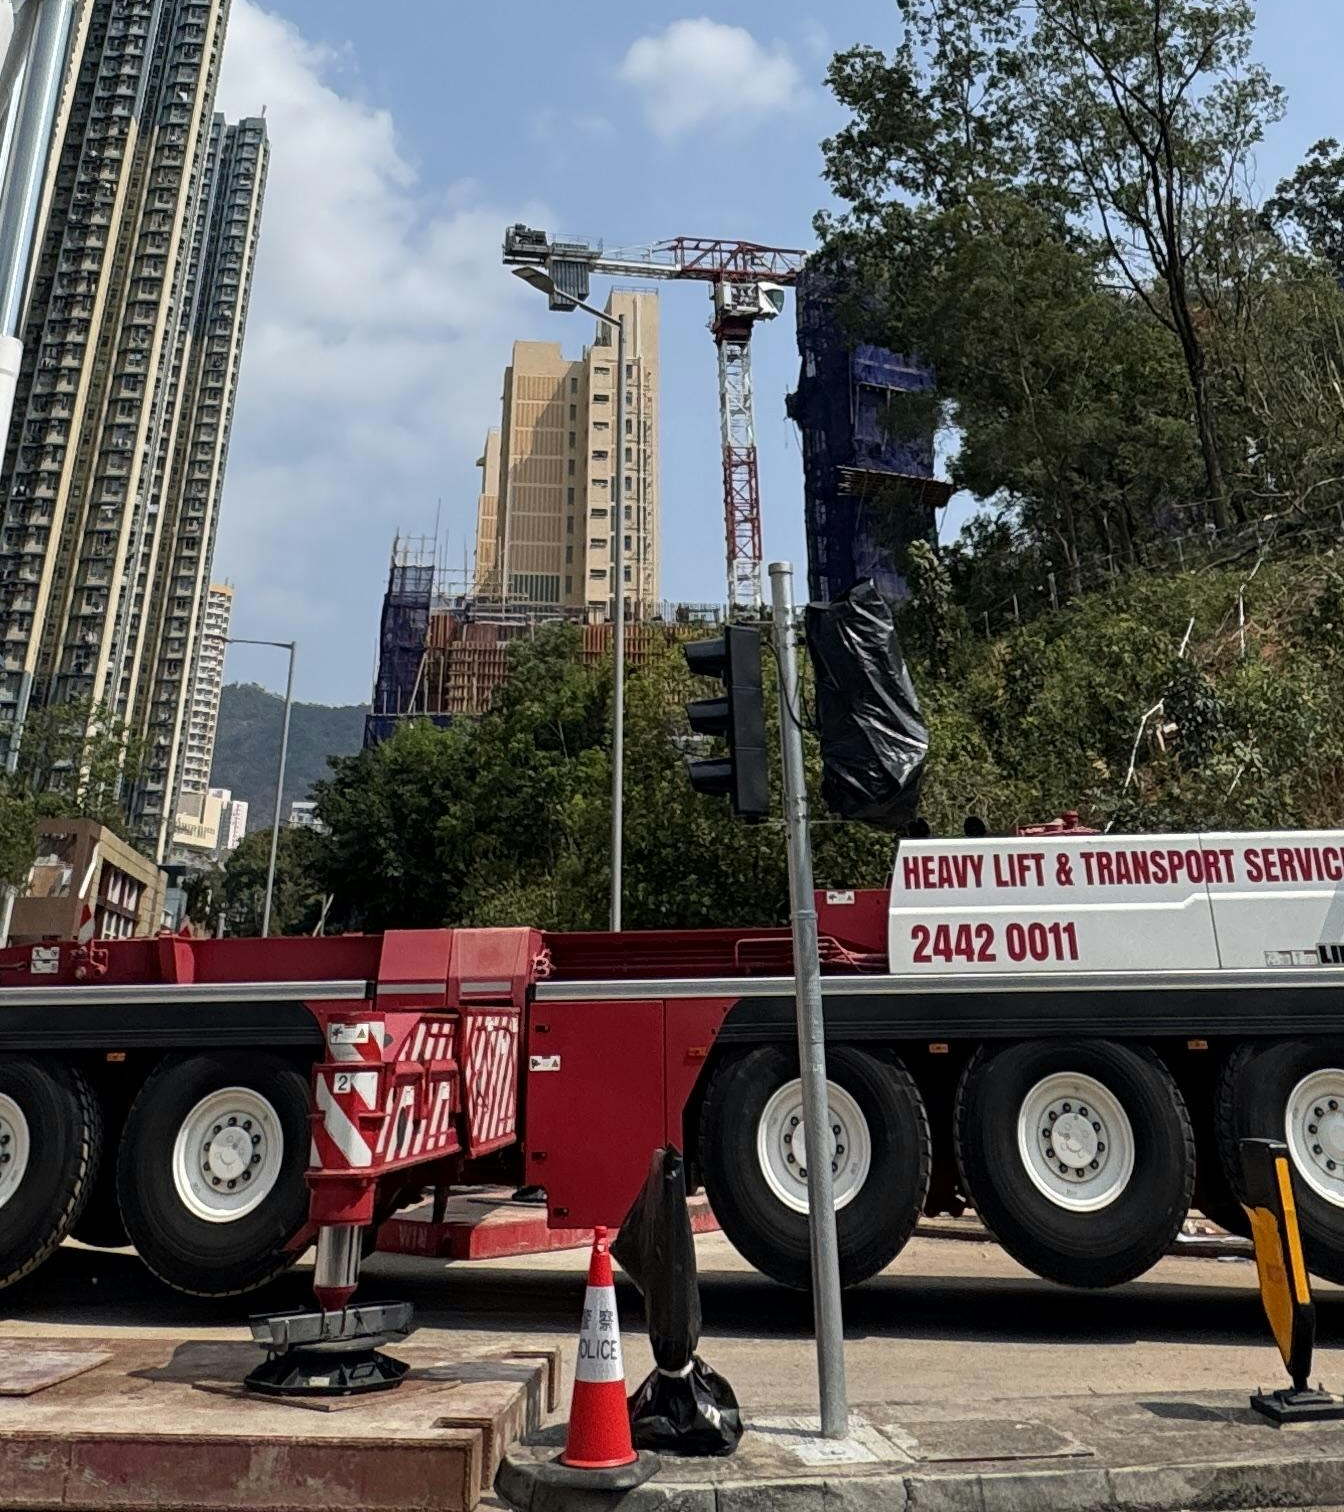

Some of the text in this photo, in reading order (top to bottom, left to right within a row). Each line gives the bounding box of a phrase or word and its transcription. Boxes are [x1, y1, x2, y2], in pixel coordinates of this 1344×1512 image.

[903, 854, 984, 890] HEAVY
[994, 852, 1046, 888] LIFT
[1056, 852, 1074, 886] &
[1080, 848, 1235, 885] TRANSPORT
[911, 922, 1080, 964] 2442 0011
[337, 1075, 348, 1091] 2
[580, 1338, 618, 1360] OLICE
